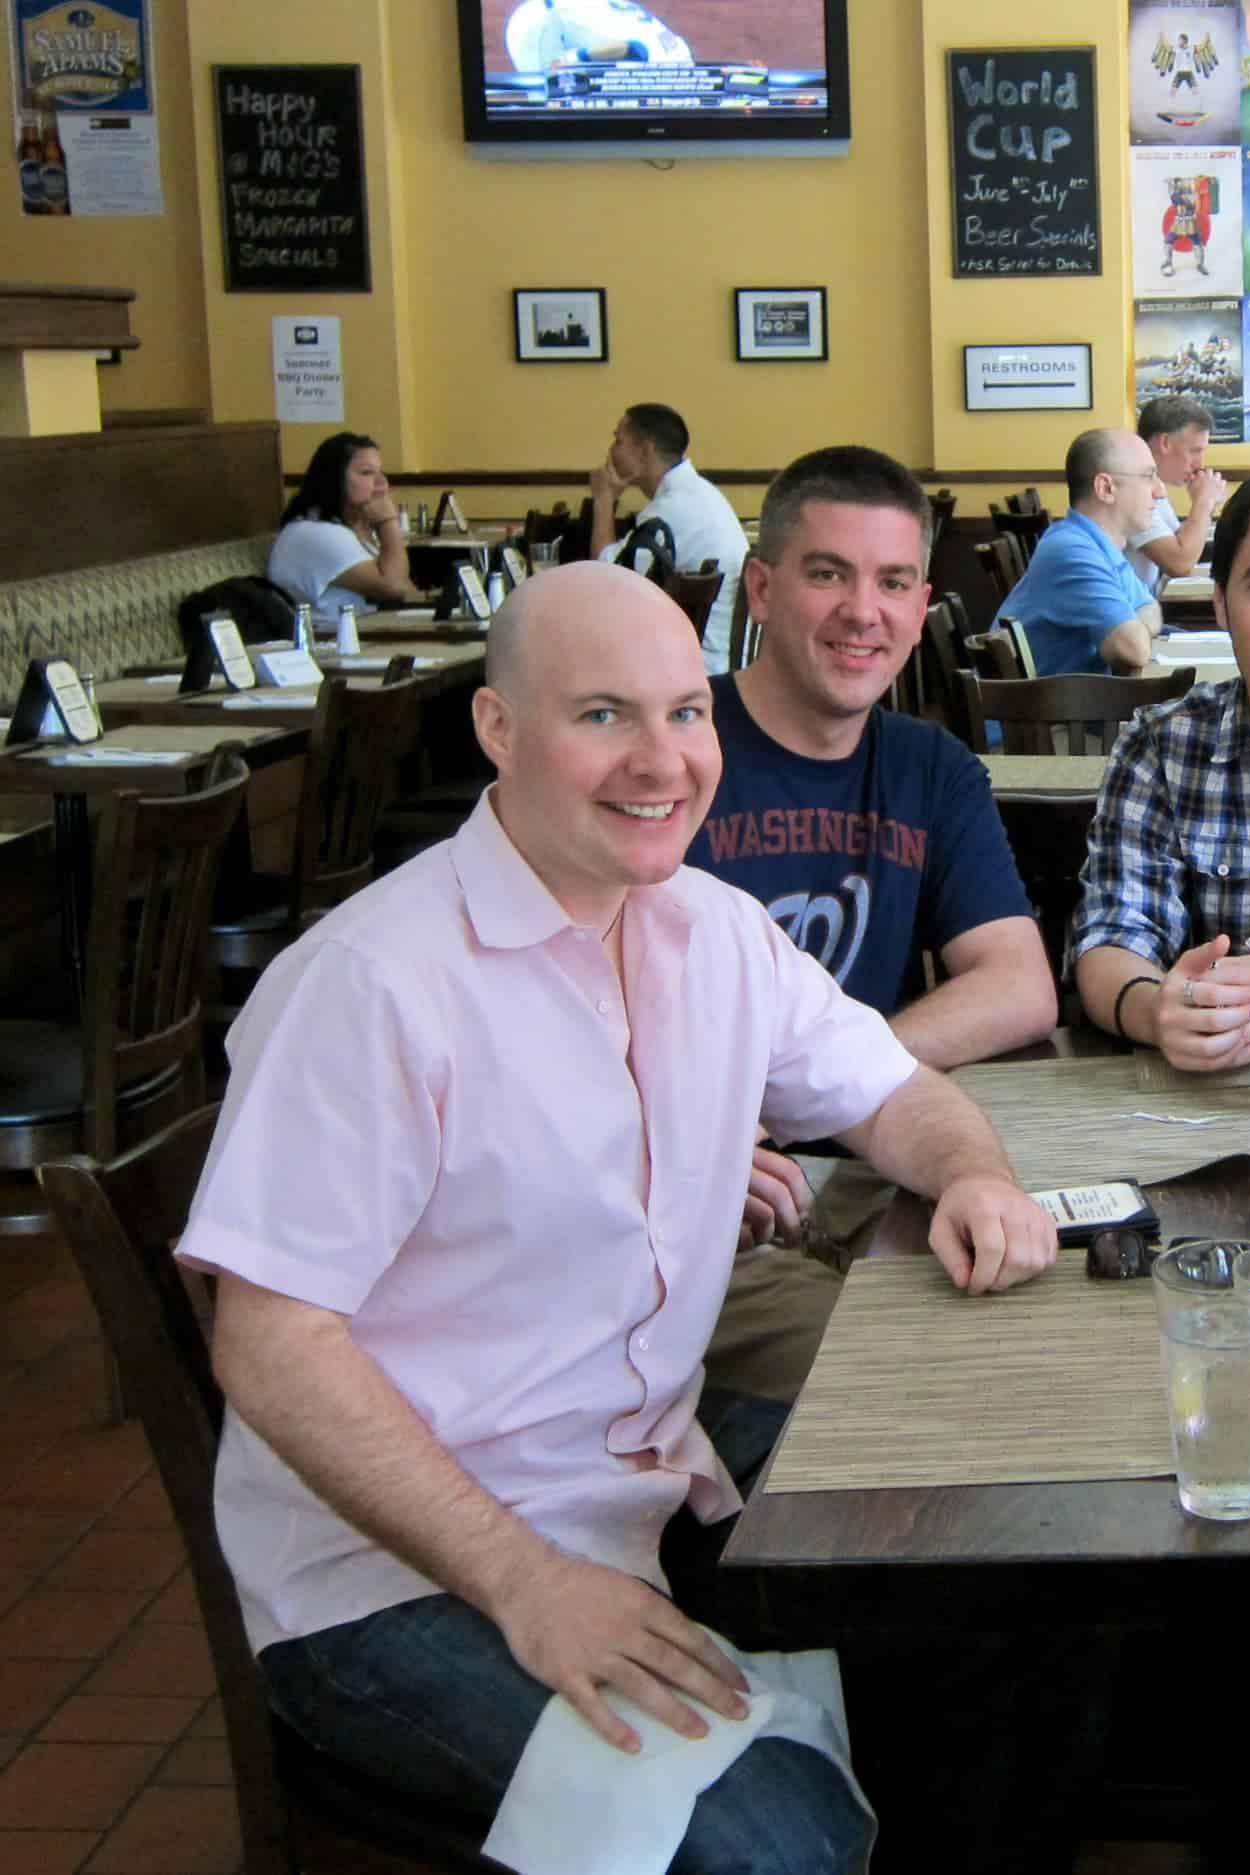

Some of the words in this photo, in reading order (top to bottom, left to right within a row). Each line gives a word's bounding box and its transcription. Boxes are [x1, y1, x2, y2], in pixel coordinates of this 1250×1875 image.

[34, 29, 123, 54] SAMUEL
[41, 50, 124, 76] ADAMS
[958, 58, 1079, 110] World
[226, 83, 316, 122] Happy
[257, 120, 337, 148] HOUR
[1031, 180, 1068, 211] July
[965, 214, 1021, 246] Beer
[981, 361, 1077, 374] RESTROOMS
[706, 808, 928, 872] WASHNGTON
